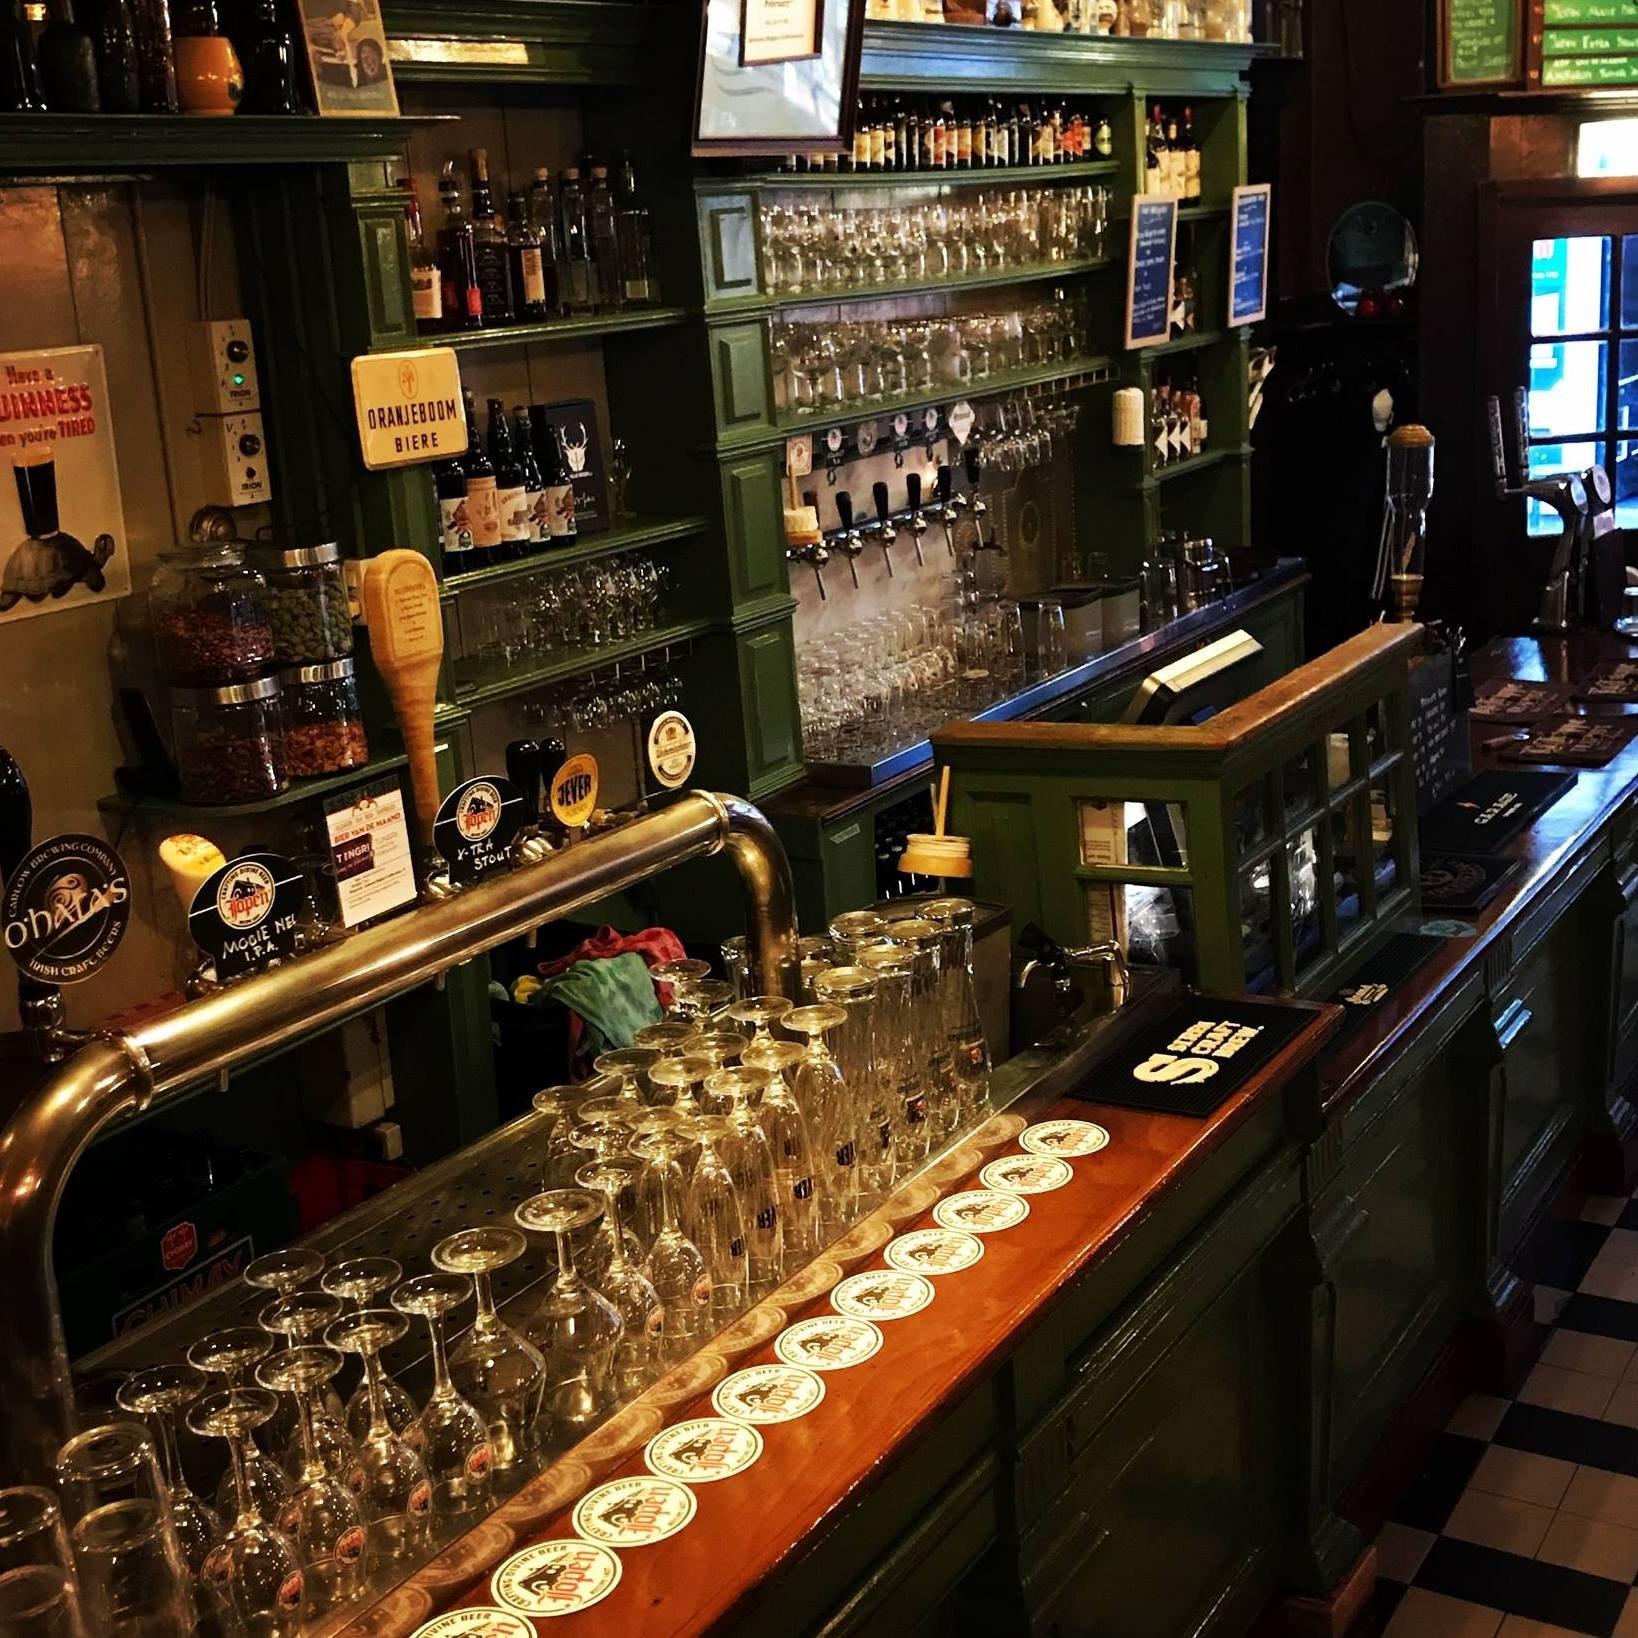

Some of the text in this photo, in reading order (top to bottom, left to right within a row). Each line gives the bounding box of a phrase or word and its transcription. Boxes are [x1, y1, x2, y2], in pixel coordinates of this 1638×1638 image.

[5, 365, 54, 385] Have a
[58, 417, 96, 438] TIRED
[367, 399, 457, 430] ORANJEBOOM
[394, 432, 439, 453] BIERE
[557, 774, 592, 807] JEVER
[335, 842, 371, 864] TINGRI
[473, 845, 513, 871] STOUT
[224, 889, 270, 920] Jopen
[689, 1427, 740, 1473] Jopen
[618, 1486, 674, 1536] Jopen
[537, 1551, 600, 1606] Jopen
